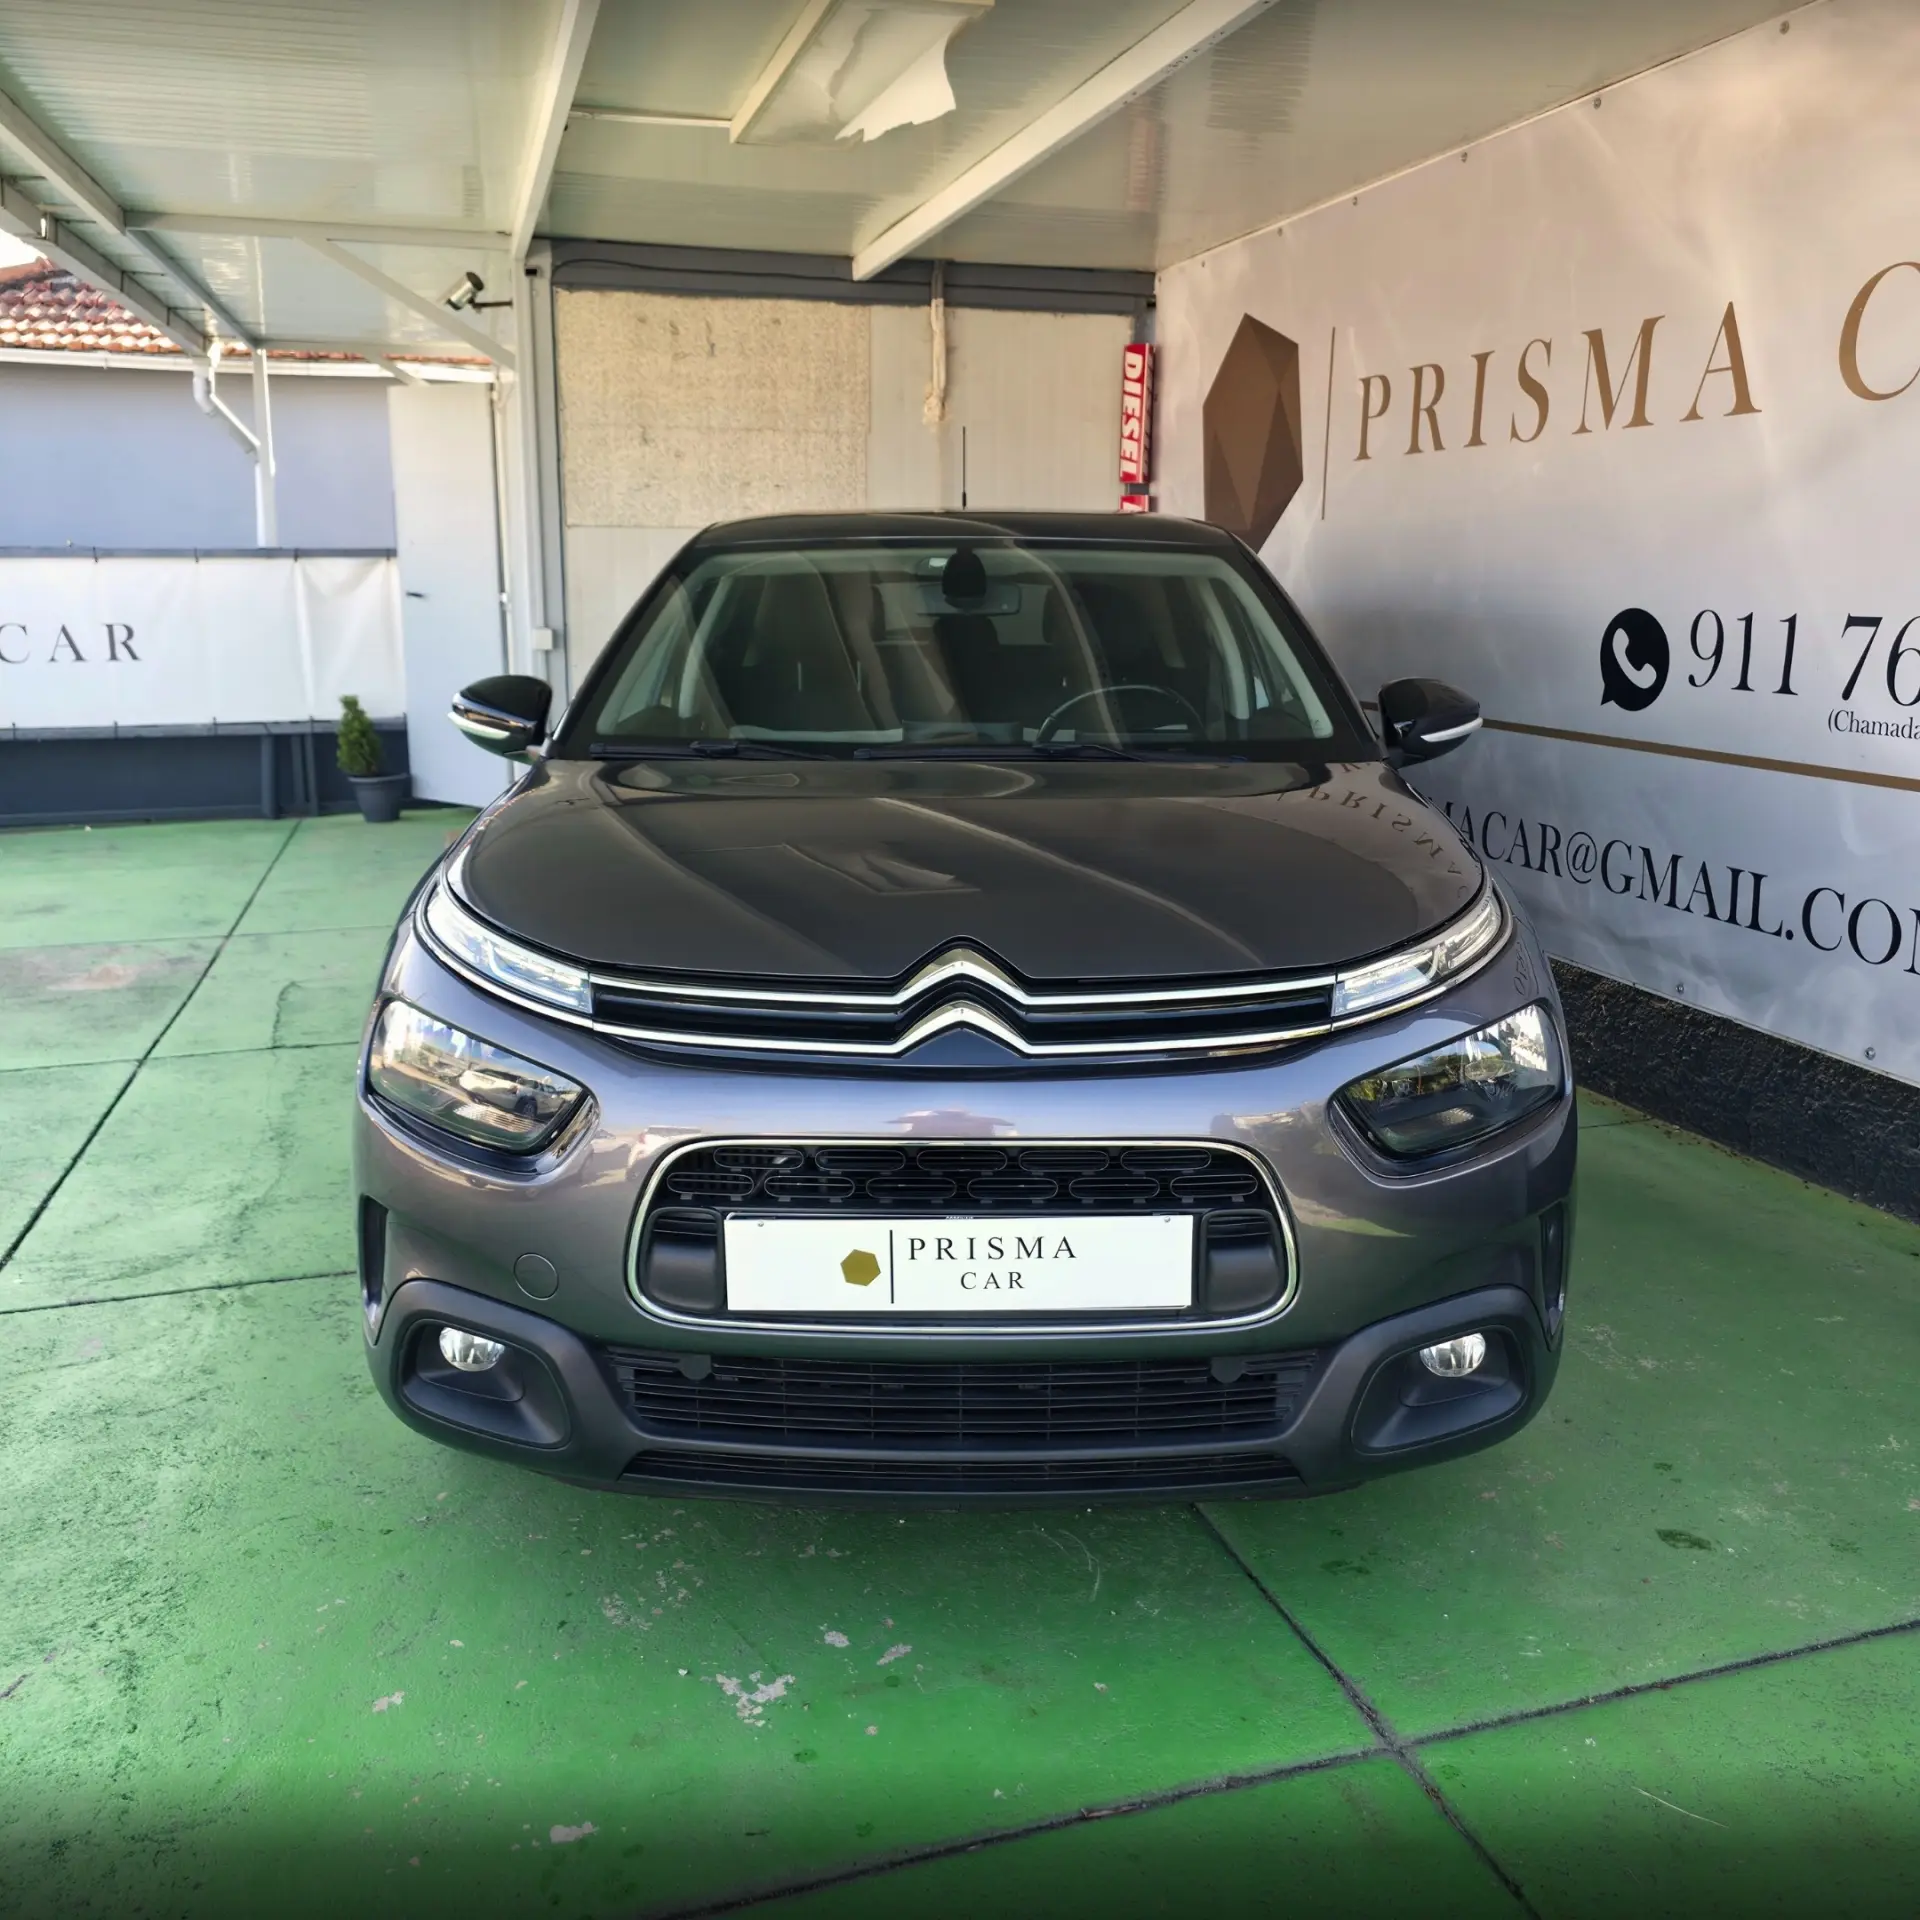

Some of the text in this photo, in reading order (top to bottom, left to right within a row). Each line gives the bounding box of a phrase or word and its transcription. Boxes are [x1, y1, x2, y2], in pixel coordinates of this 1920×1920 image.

[1119, 351, 1144, 478] DIESEL
[1353, 300, 1763, 461] PRISMA
[0, 622, 141, 665] CAR
[1688, 609, 1920, 707] 911 76
[1428, 797, 1920, 977] ACAR@GMAIL.CO
[907, 1235, 1078, 1261] PRISMA
[960, 1271, 1026, 1290] CAR
